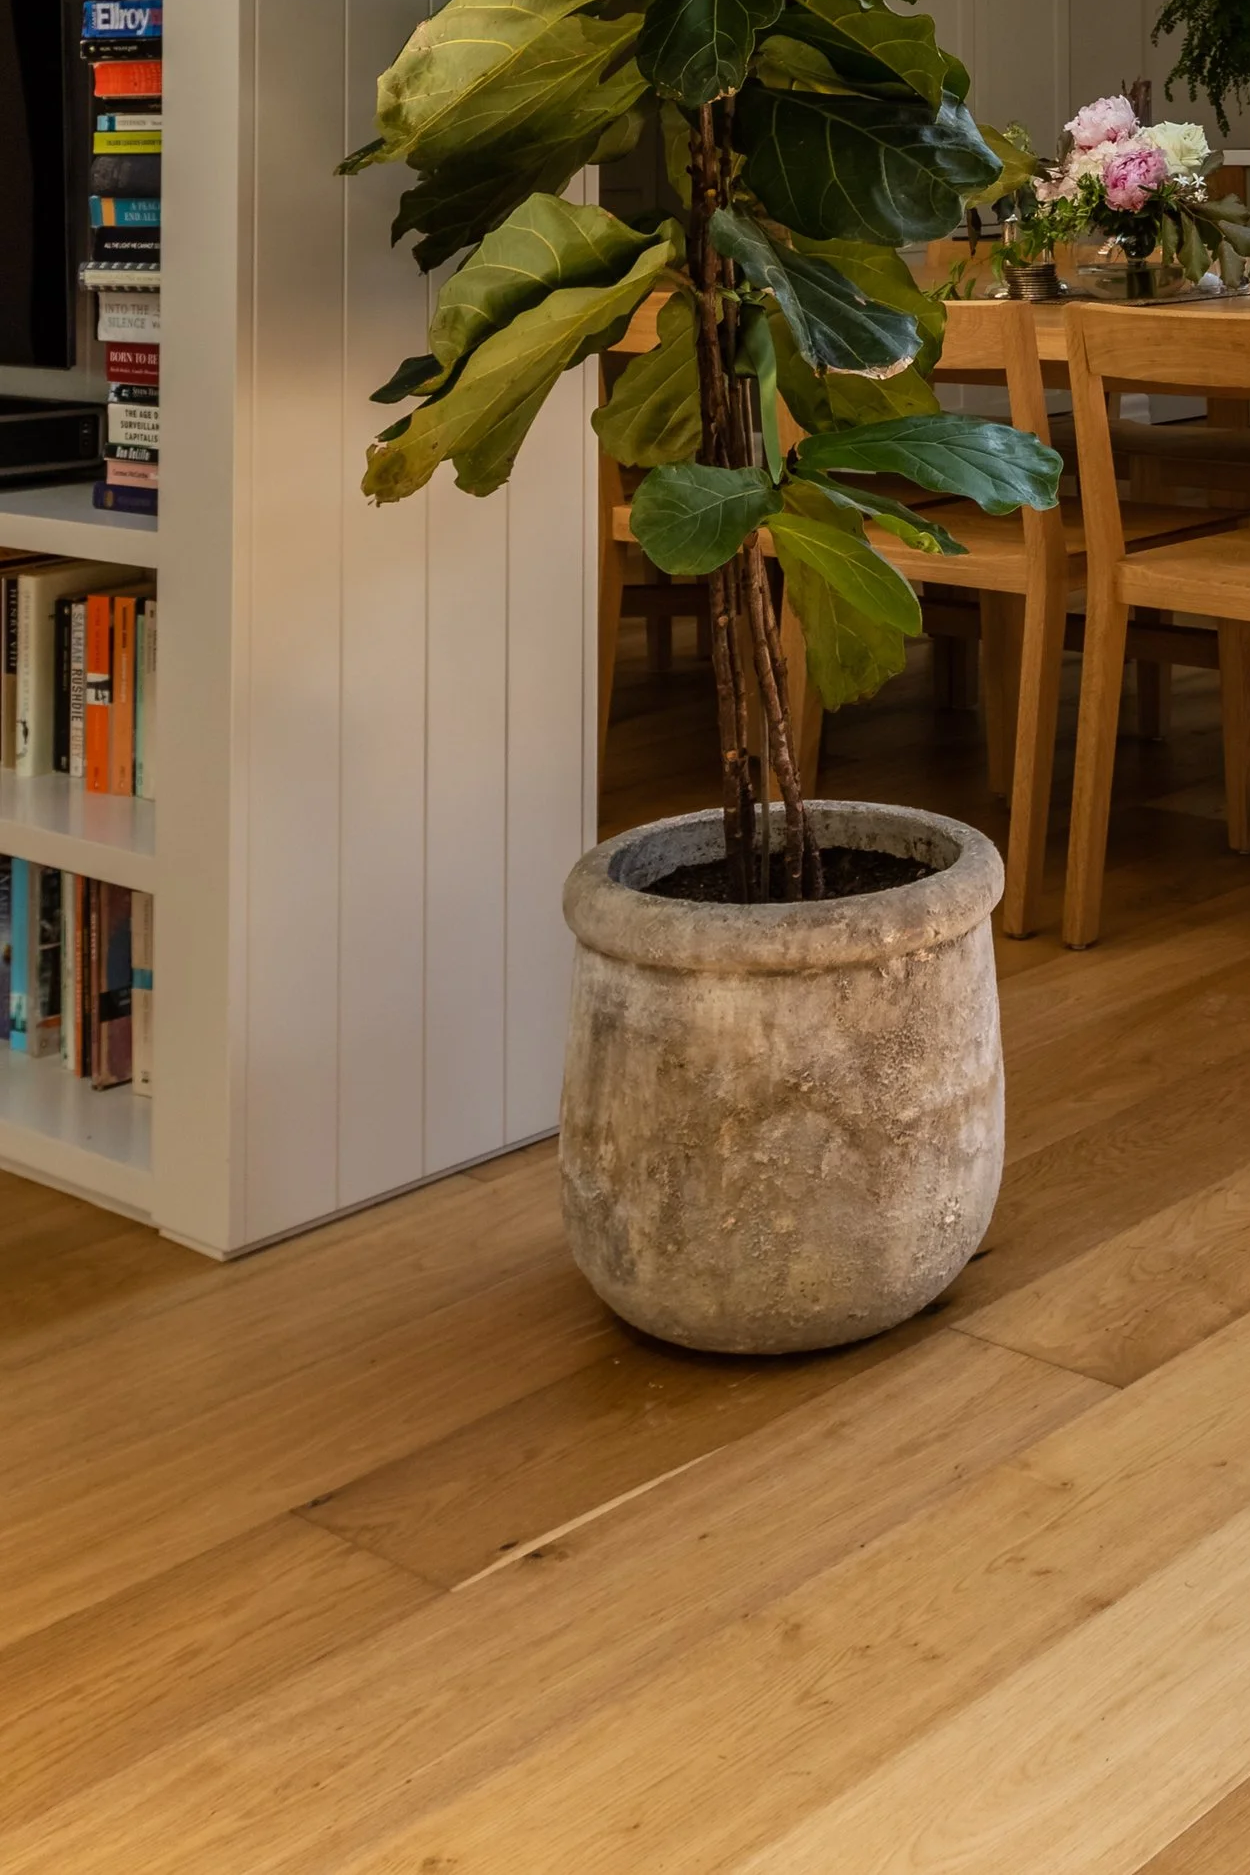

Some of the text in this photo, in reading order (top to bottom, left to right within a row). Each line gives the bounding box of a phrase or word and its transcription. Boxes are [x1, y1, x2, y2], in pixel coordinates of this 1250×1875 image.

[96, 2, 150, 36] Ellroy
[124, 212, 157, 222] END ALL
[105, 303, 149, 315] INTO THE
[107, 316, 145, 329] SILENCE
[110, 351, 132, 363] BORN
[135, 353, 146, 365] TO
[125, 408, 137, 418] THE
[139, 410, 152, 419] AGE
[116, 446, 150, 461] Don DeLillo
[9, 588, 17, 668] HENRY VIII
[71, 612, 83, 757] SALMAN RUSHDIE FURY
